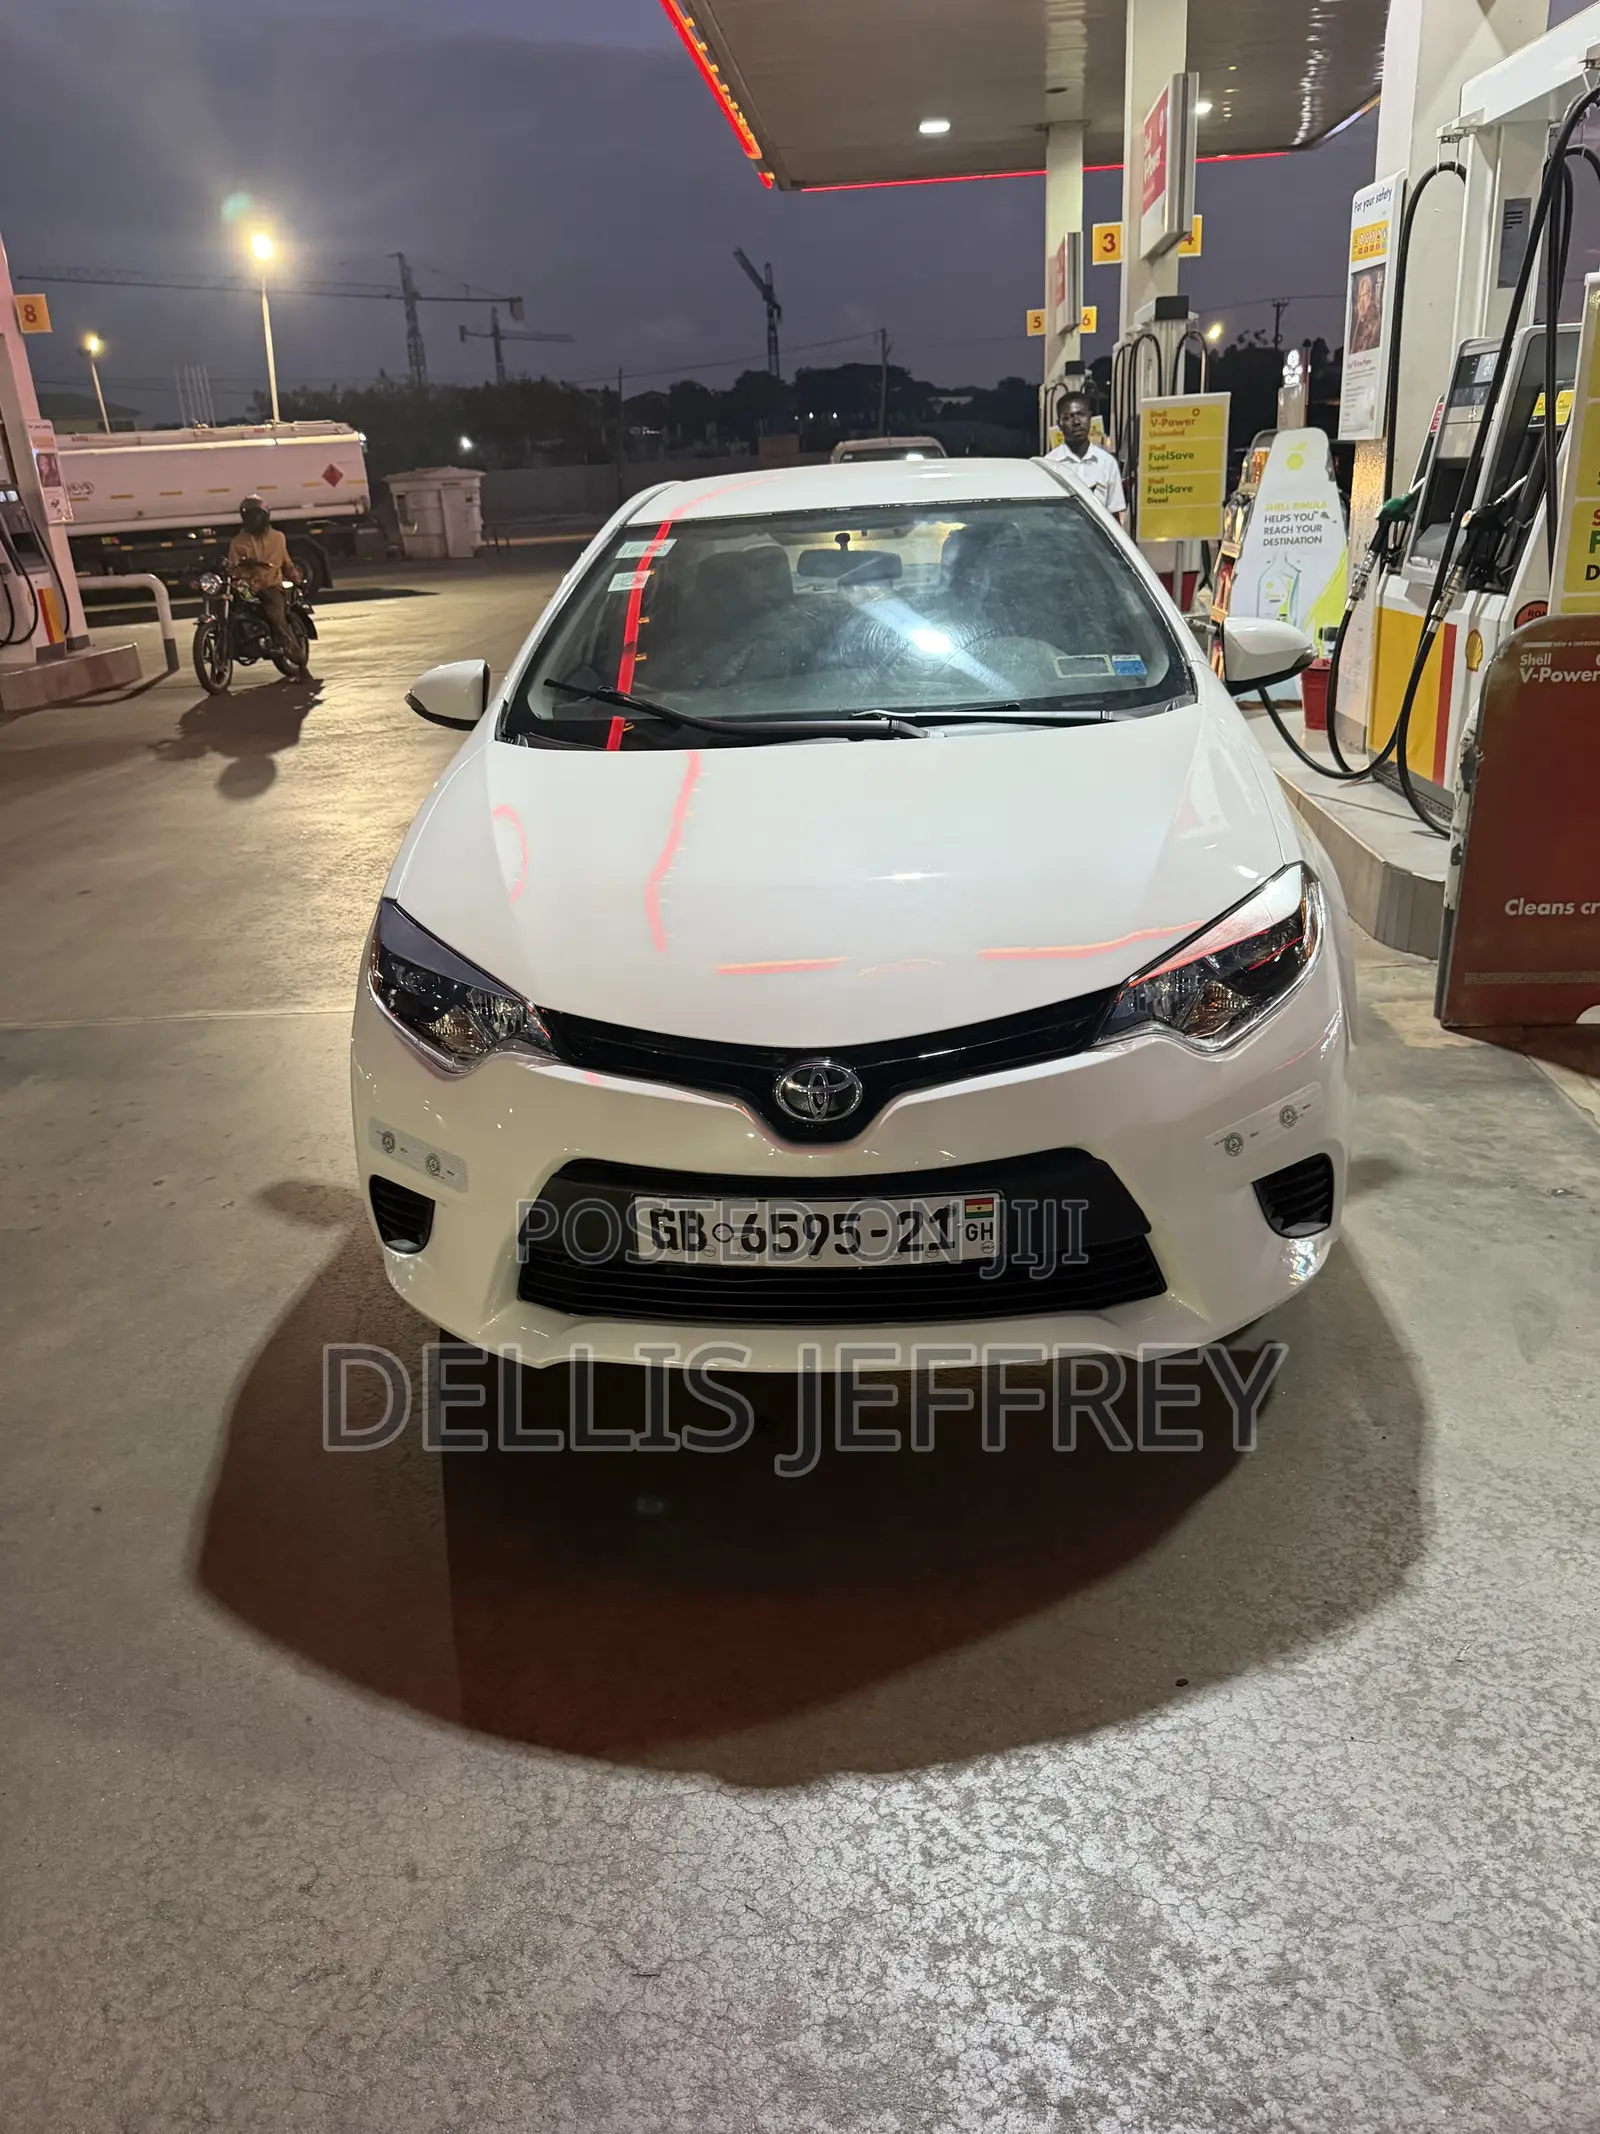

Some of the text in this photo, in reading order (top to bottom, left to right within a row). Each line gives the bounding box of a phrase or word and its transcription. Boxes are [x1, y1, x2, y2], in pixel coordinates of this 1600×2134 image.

[1102, 233, 1116, 253] 3
[24, 304, 37, 323] 8
[1082, 314, 1091, 326] 6
[1033, 316, 1042, 329] 5
[1150, 418, 1196, 428] V-Power
[1148, 451, 1195, 461] FuelSave
[1147, 484, 1194, 494] FuelSave
[1264, 512, 1315, 524] HELPS YOU
[1263, 524, 1323, 535] REACH YOUR
[1263, 536, 1323, 547] DESTINATION
[1520, 652, 1552, 667] Shell
[1519, 667, 1600, 684] V-Power
[1504, 898, 1575, 916] Cleans
[650, 1208, 707, 1252] GB
[965, 1222, 994, 1242] GH
